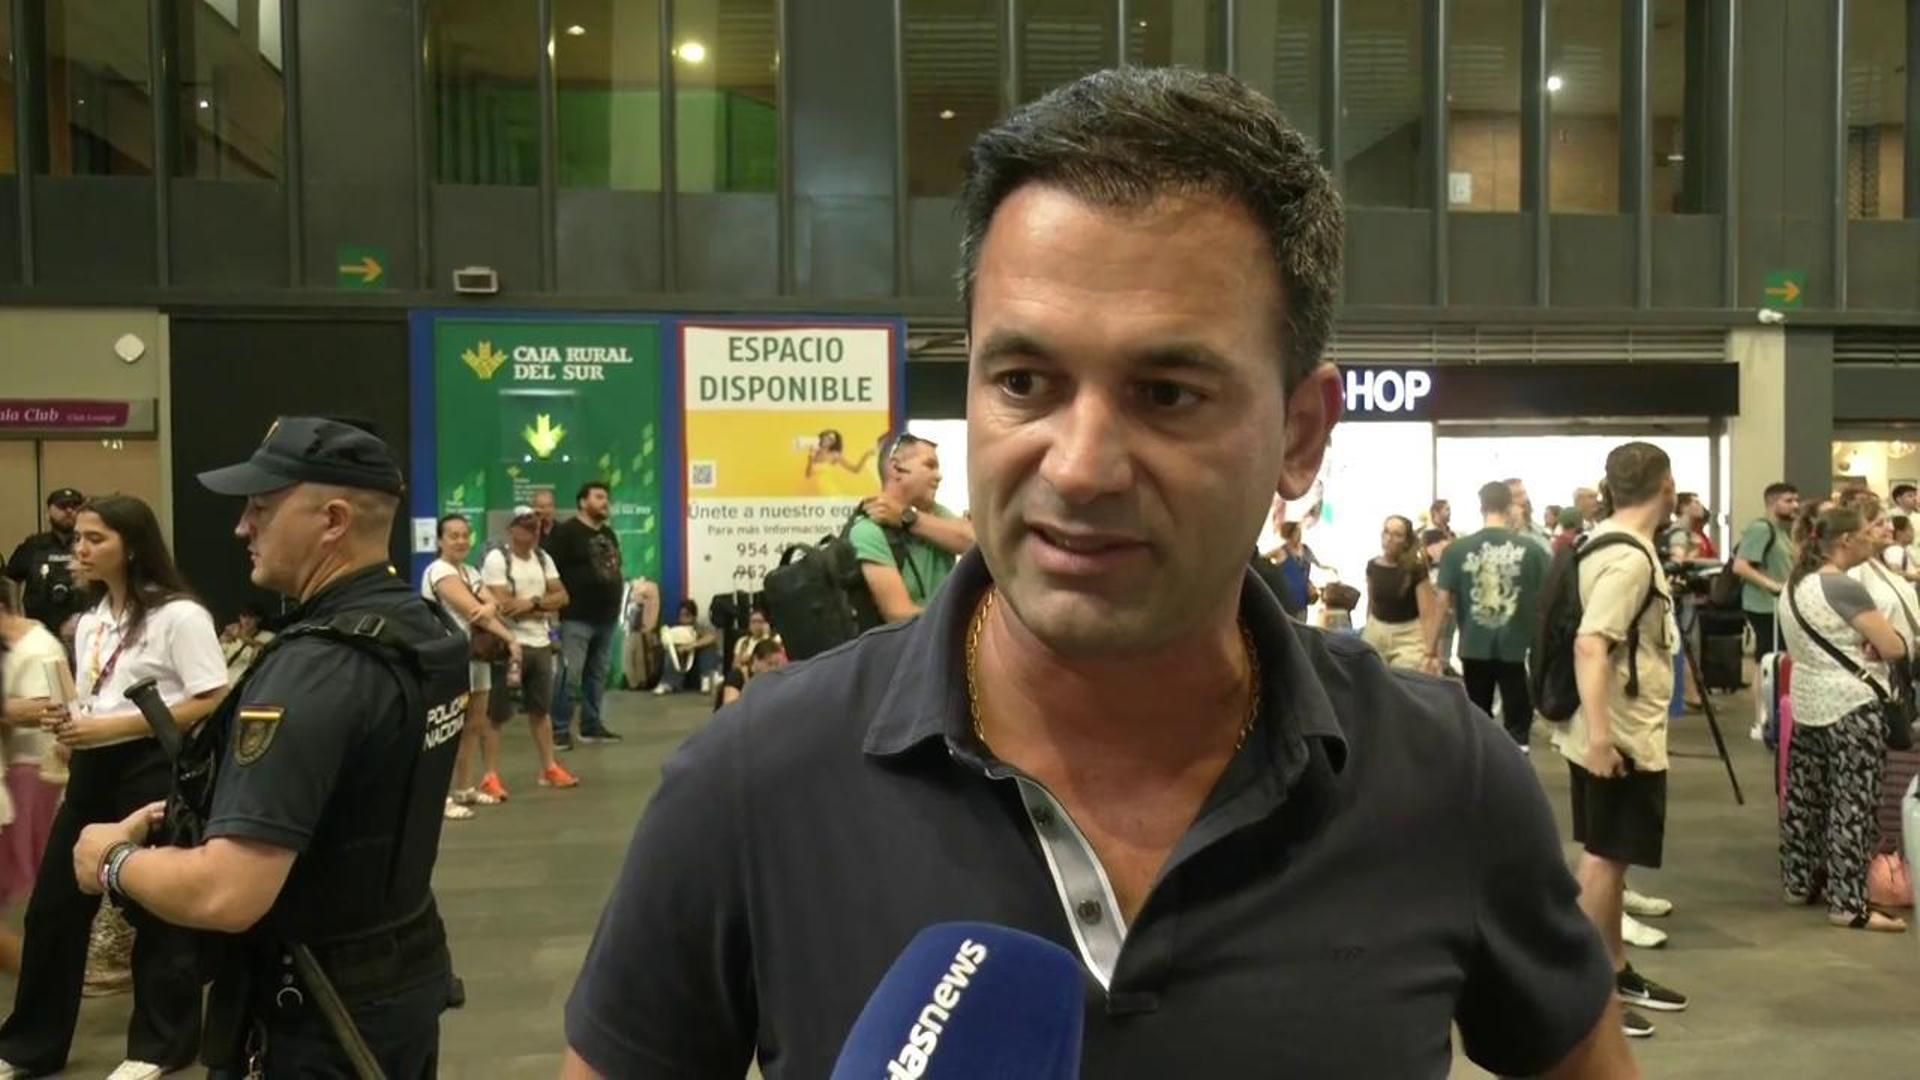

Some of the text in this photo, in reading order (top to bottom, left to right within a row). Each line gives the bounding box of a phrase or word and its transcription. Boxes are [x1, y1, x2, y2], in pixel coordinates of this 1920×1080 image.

[513, 346, 633, 363] CAJA RURAL
[728, 336, 844, 363] ESPACIO
[514, 364, 605, 381] DEL SUR
[700, 375, 872, 402] DISPONIBLE
[1342, 370, 1431, 412] HOP
[0, 407, 20, 421] ala
[24, 407, 59, 422] Club
[744, 506, 755, 519] a
[760, 504, 825, 519] nuestro
[707, 524, 733, 536] Para
[737, 542, 769, 557] 954
[885, 938, 988, 1080] lasnews
